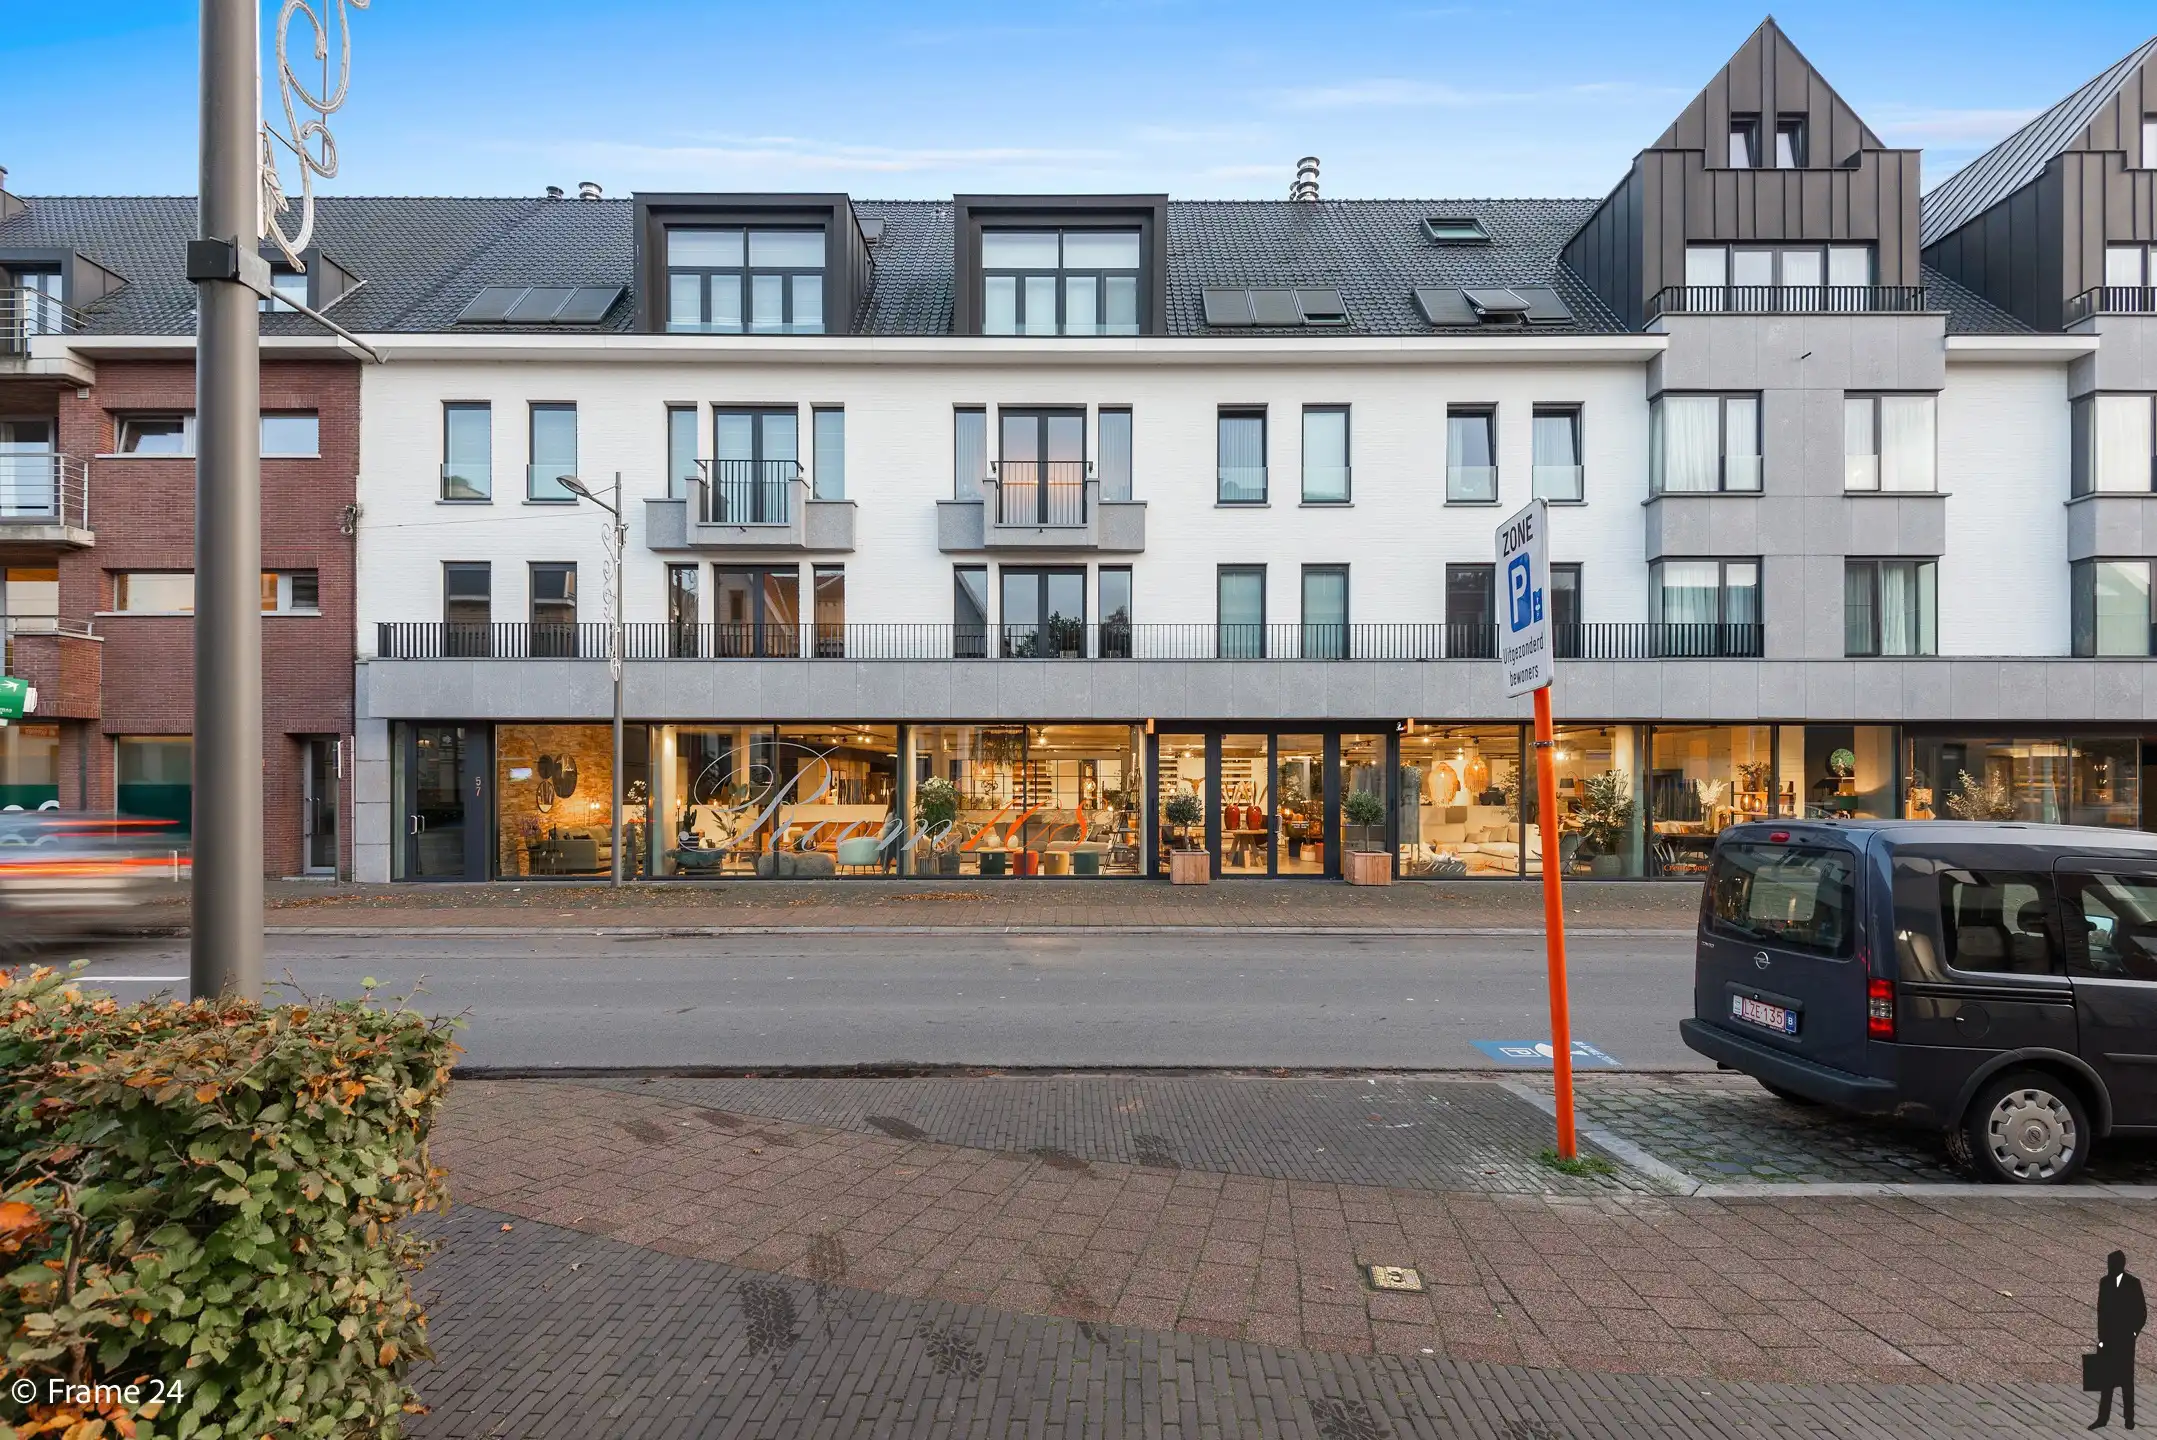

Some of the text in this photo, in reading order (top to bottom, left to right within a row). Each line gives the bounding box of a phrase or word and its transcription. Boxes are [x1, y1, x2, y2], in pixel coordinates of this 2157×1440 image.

[1502, 513, 1534, 558] ZONE
[1503, 632, 1544, 666] Uitgezonderd
[1509, 665, 1539, 687] bewoners
